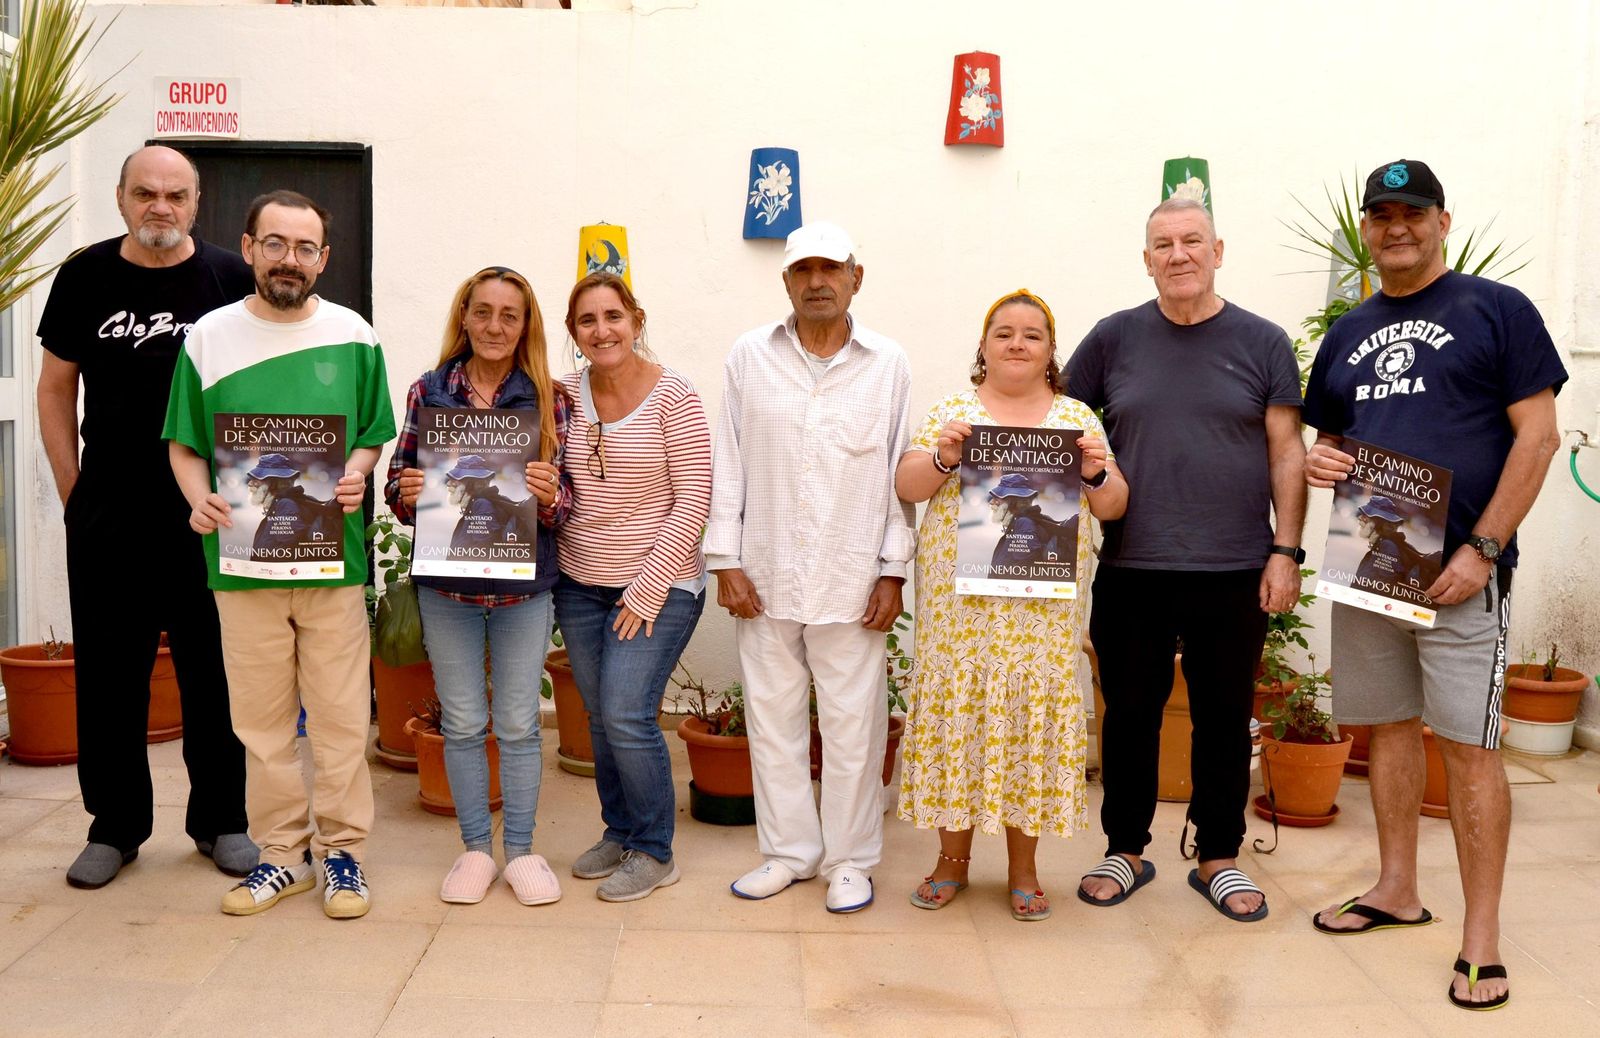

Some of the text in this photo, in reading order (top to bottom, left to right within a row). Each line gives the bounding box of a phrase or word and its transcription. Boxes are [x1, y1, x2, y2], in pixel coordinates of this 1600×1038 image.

[169, 82, 227, 105] GRUPO
[157, 110, 238, 133] CONTRAINCENDIOS
[1355, 377, 1426, 401] ROMA
[233, 417, 324, 430] EL CAMINO
[435, 414, 519, 430] EL CAMINO
[224, 430, 336, 445] DE SANTIAGO
[427, 431, 531, 446] DE SANTIAGO
[980, 431, 1063, 448] EL CAMINO
[970, 448, 1073, 466] DE SANTIAGO
[1358, 447, 1433, 483] EL CAMINO
[1366, 467, 1441, 503] SANTIAGO
[225, 544, 338, 559] CAMINEMOS JUNTOS
[420, 546, 530, 559] CAMINEMOS JUNTOS
[962, 563, 1027, 575] CAMINEMOS
[1029, 566, 1071, 578] JUNTOS
[1327, 568, 1391, 593] CAMINEMOS
[1392, 585, 1433, 605] JUNTOS
